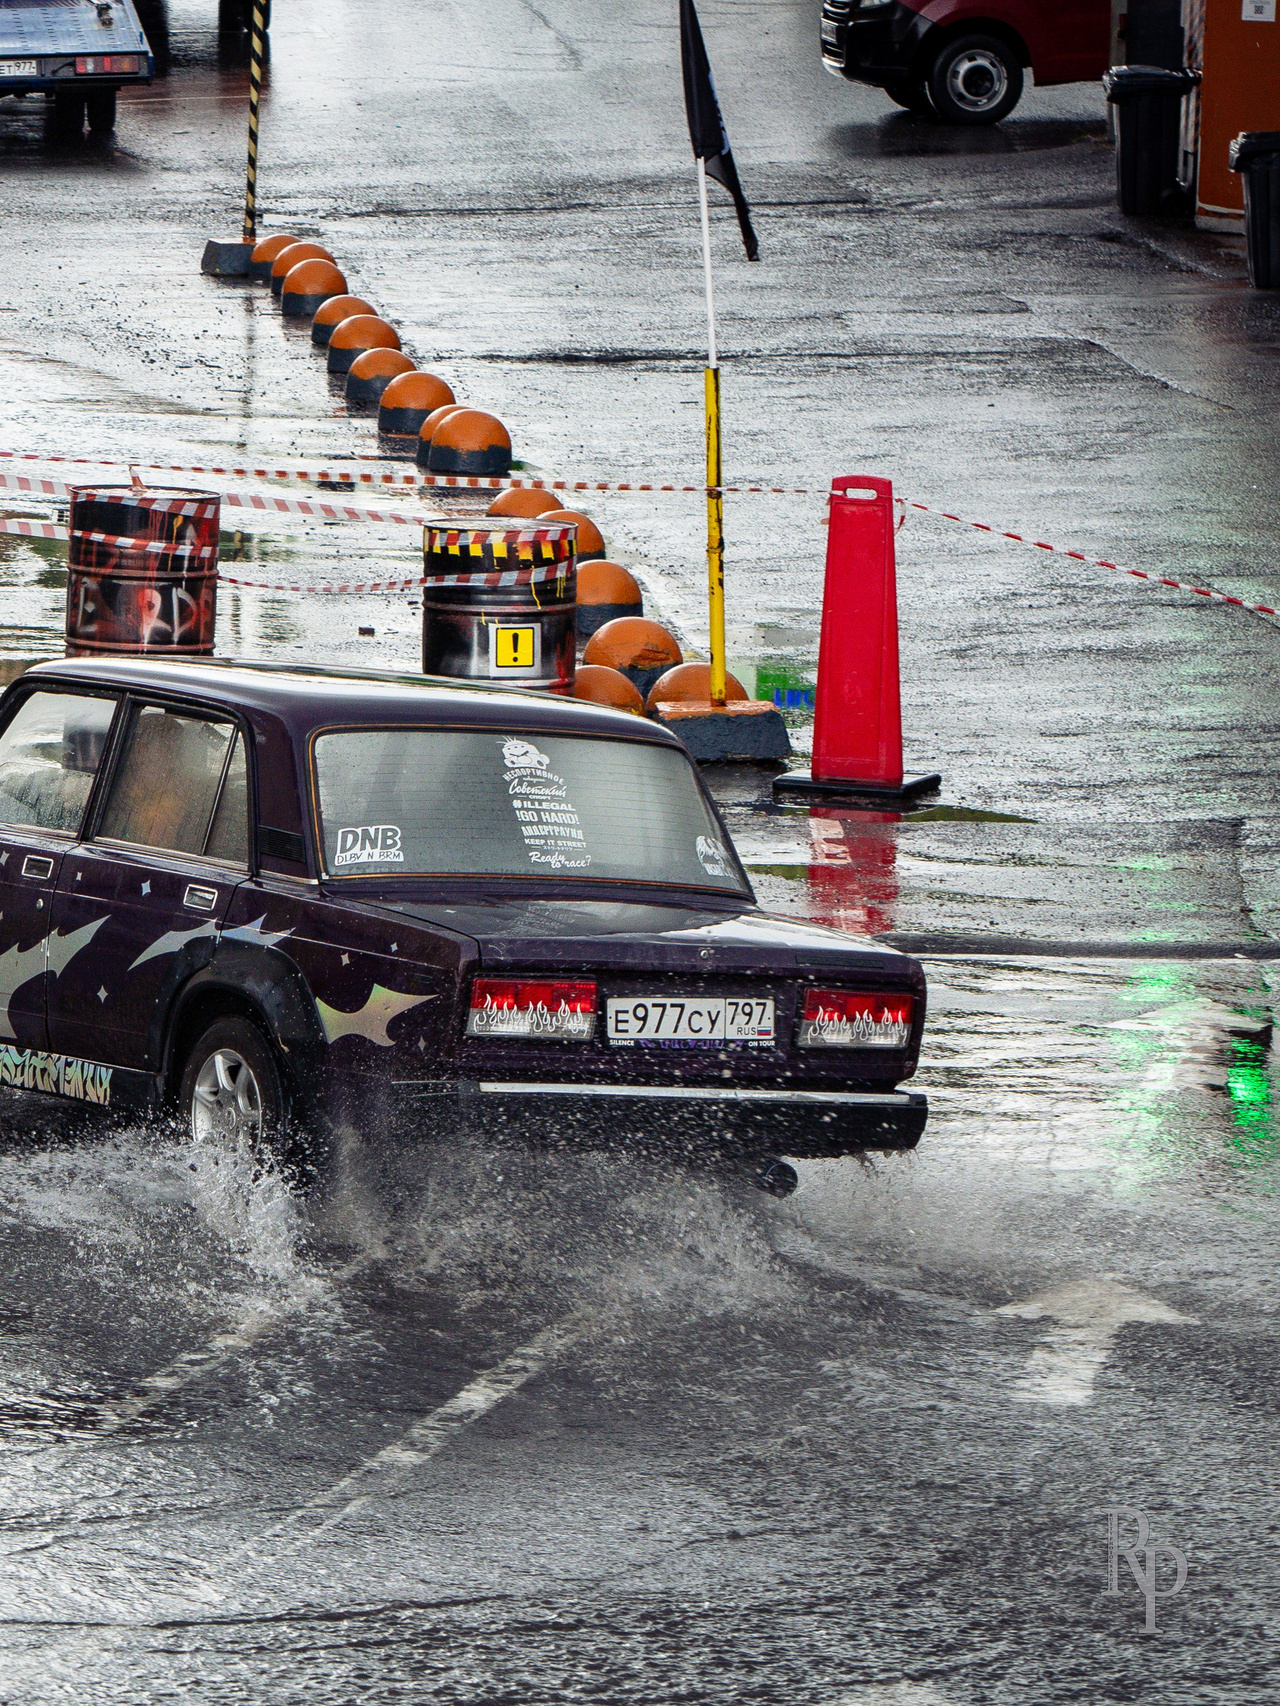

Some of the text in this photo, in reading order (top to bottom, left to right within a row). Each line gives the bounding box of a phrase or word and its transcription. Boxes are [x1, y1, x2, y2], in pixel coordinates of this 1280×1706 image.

[15, 61, 33, 71] 977
[502, 768, 565, 786] НЕСПОРТИВНОЕ
[508, 778, 567, 798] Советский
[512, 799, 576, 811] #ILLEGAL
[540, 811, 580, 825] HARD!
[339, 827, 400, 854] DNB
[557, 840, 587, 848] STREET
[367, 851, 374, 860] N
[379, 850, 401, 861] BRM
[528, 851, 566, 864] Ready
[551, 855, 592, 868] to race?
[727, 1002, 767, 1026] 797
[736, 1027, 757, 1036] RUS
[609, 1039, 635, 1047] SILENCE
